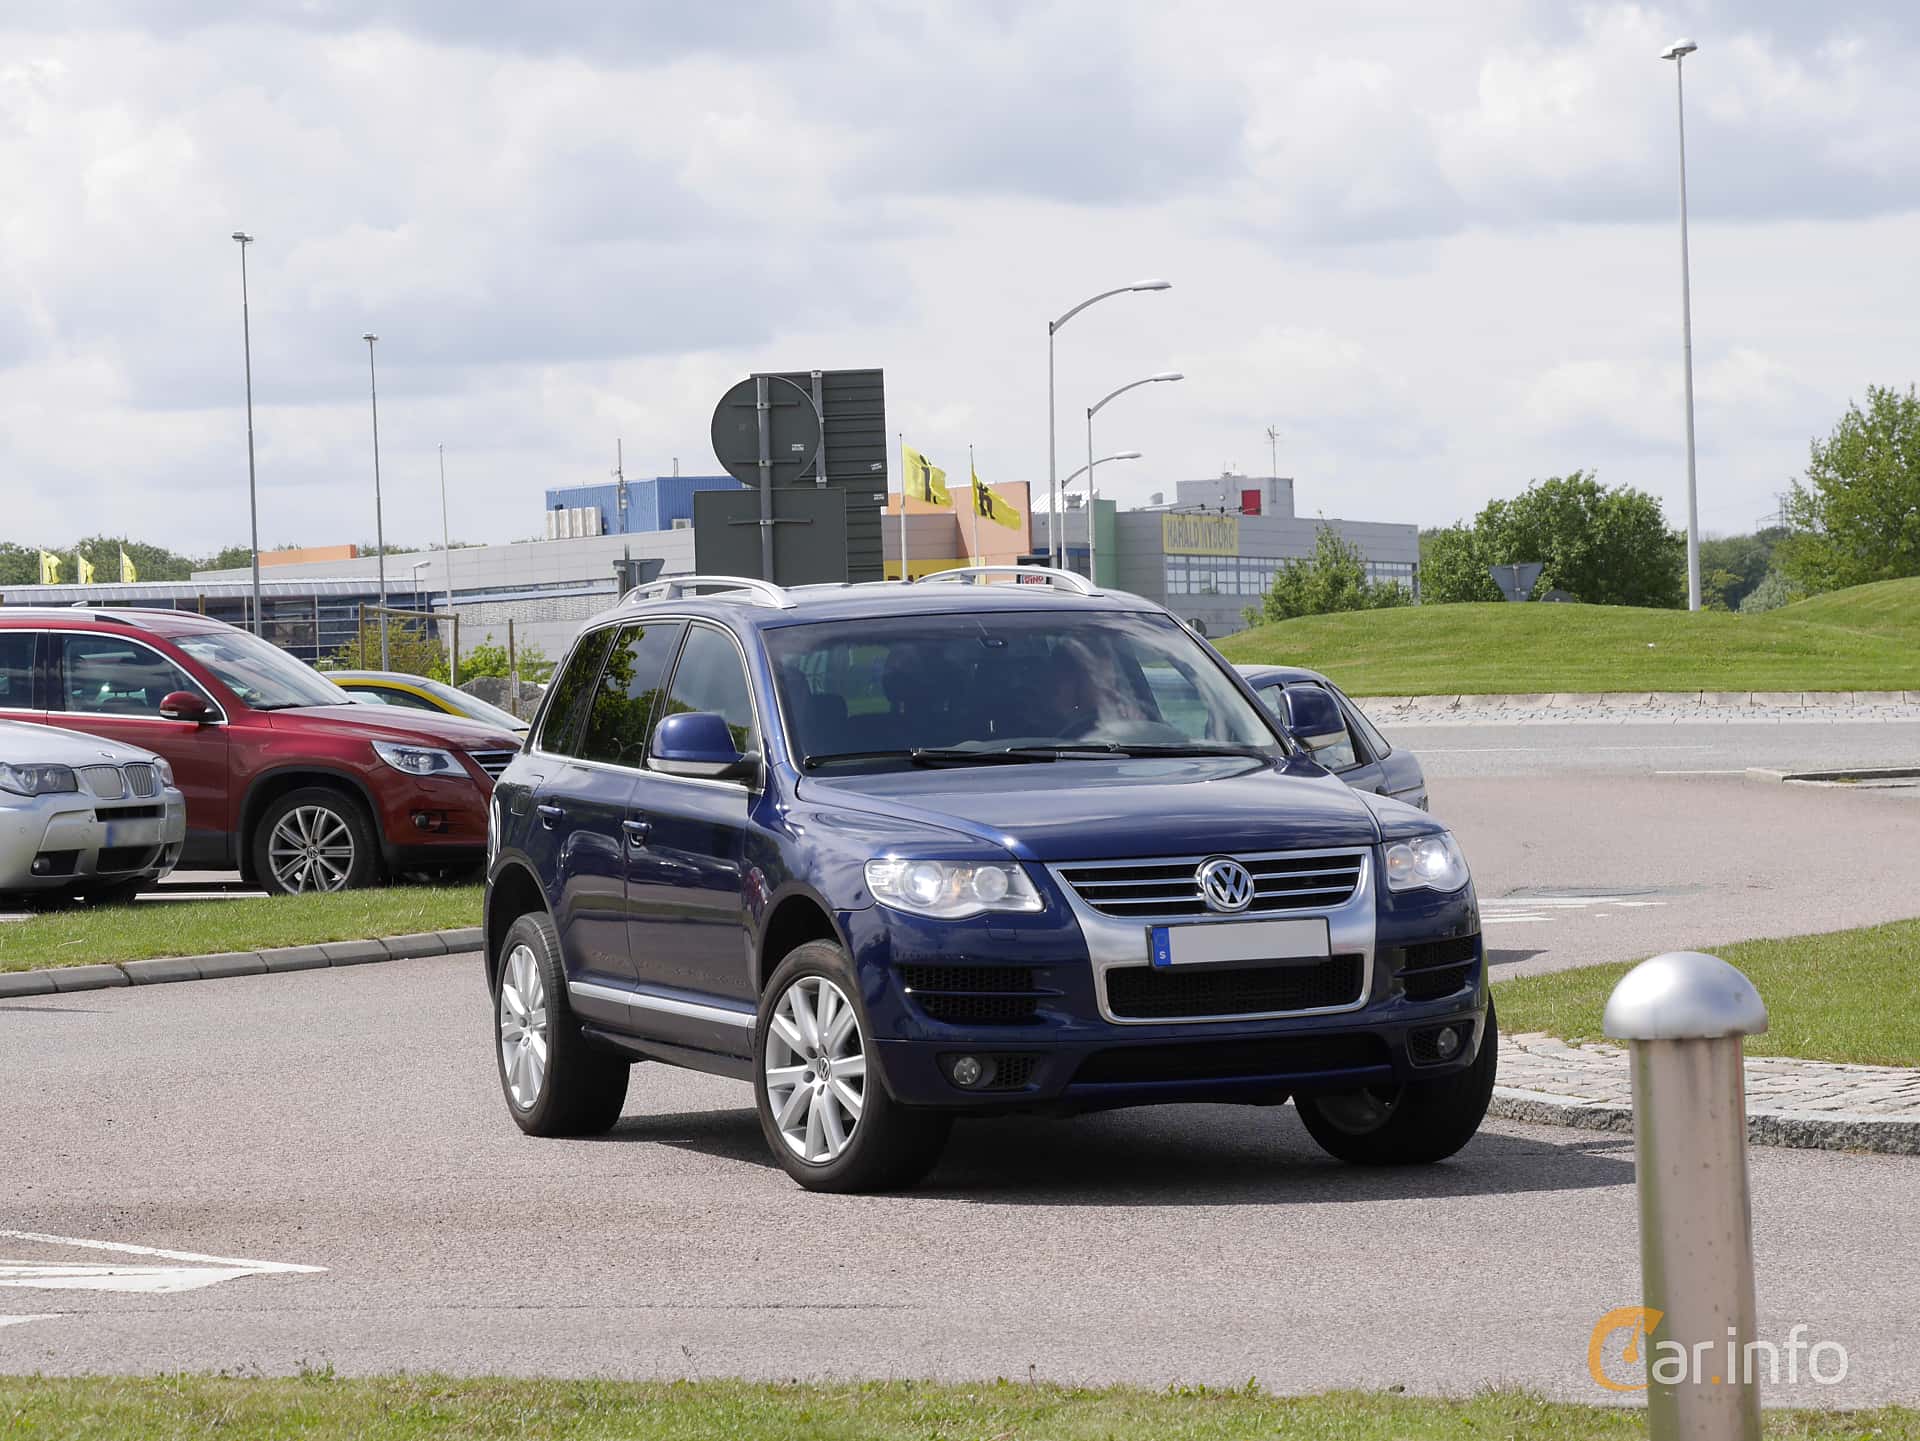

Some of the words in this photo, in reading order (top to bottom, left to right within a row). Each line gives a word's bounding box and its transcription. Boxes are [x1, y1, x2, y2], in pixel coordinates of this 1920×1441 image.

[1167, 519, 1200, 549] HARALD
[1201, 520, 1234, 550] NYBORG
[1159, 951, 1167, 960] S
